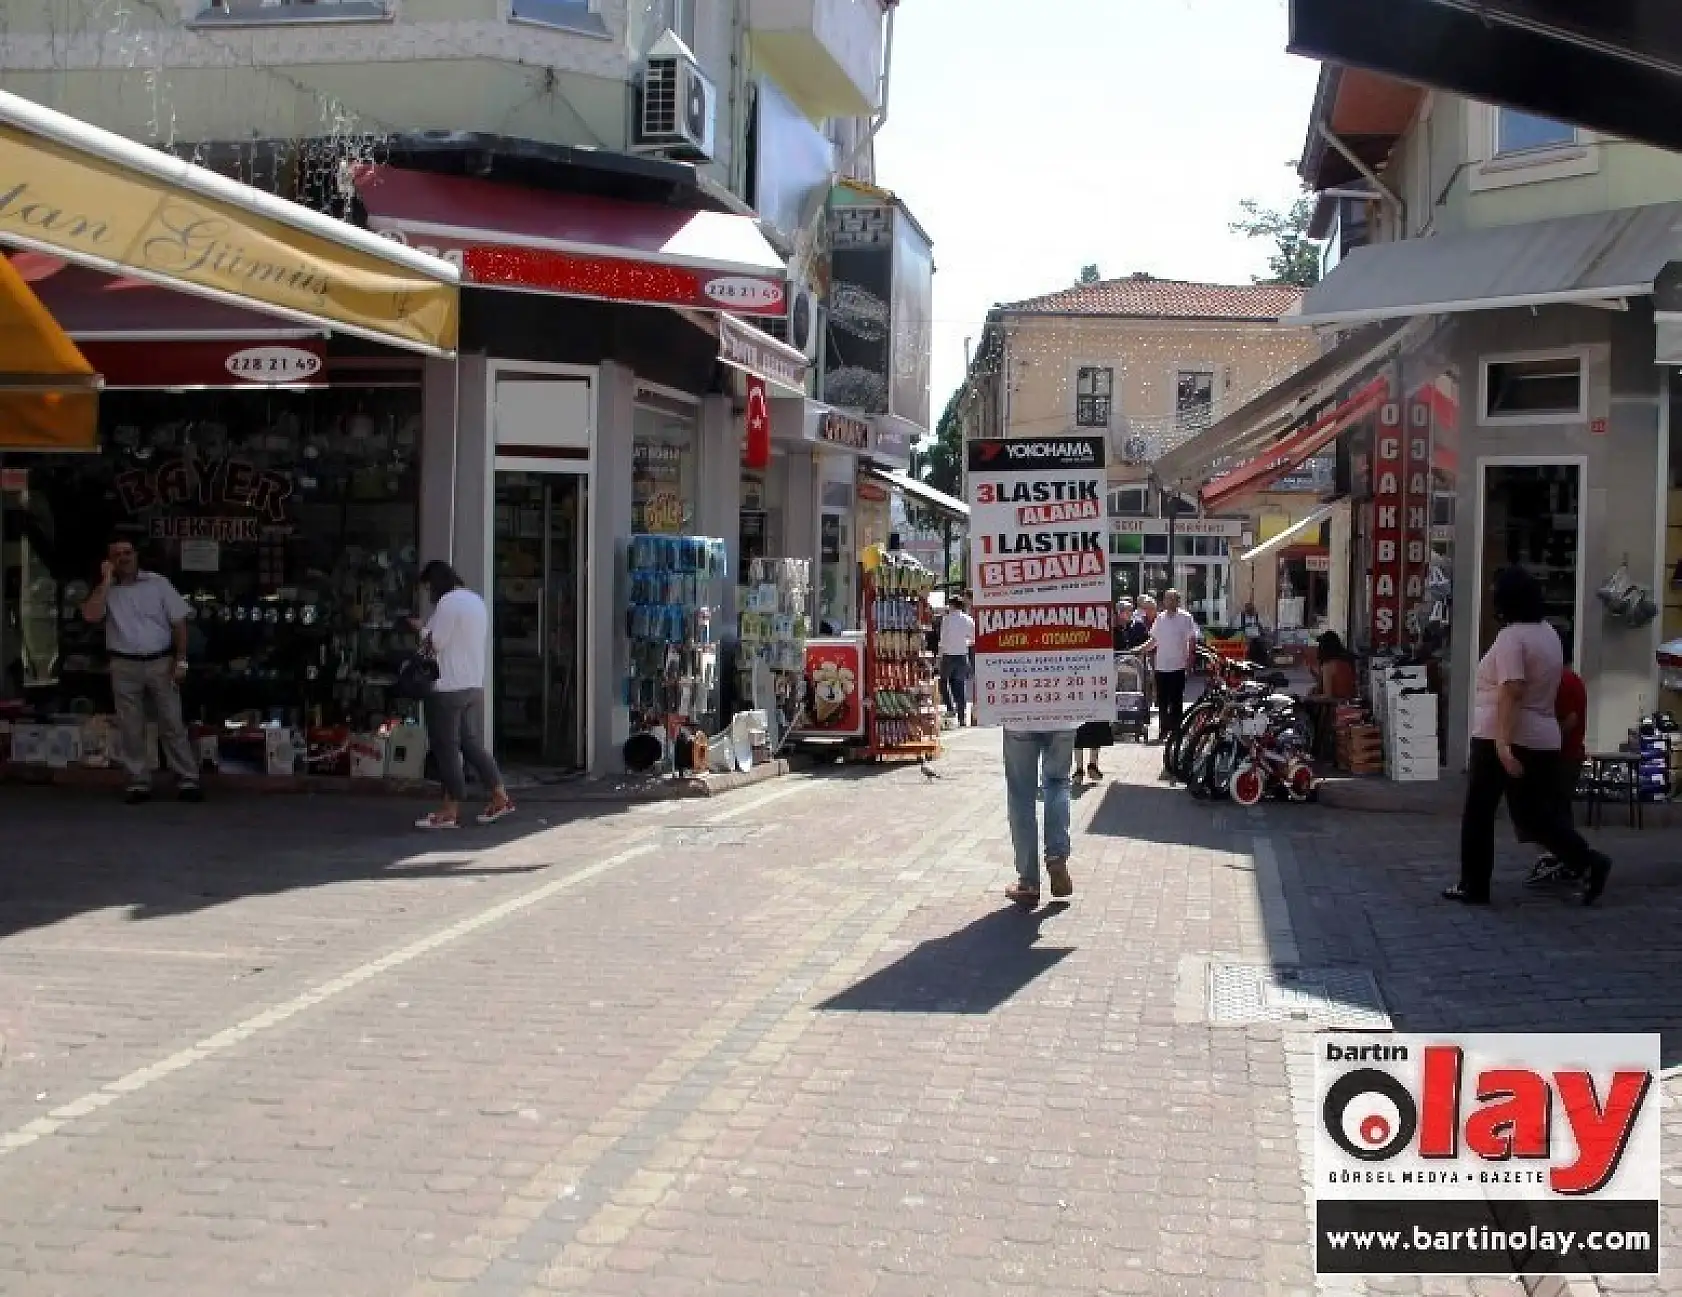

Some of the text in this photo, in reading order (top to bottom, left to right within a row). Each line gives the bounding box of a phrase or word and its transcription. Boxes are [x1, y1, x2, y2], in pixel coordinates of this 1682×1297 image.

[710, 284, 736, 297] 228
[740, 286, 757, 298] 21
[231, 358, 317, 371] 228 21 49
[1005, 442, 1093, 458] YOKOHAMA
[113, 456, 293, 522] BAYER
[977, 483, 996, 504] 3
[1023, 502, 1099, 525] ALANA
[980, 535, 993, 555] 1
[985, 552, 1102, 586] BEDAVA
[978, 605, 1110, 636] KARAMANLAR
[986, 680, 996, 691] 0
[1000, 678, 1028, 690] 378
[1091, 675, 1108, 687] 18
[986, 693, 996, 705] 0
[1091, 689, 1108, 701] 15
